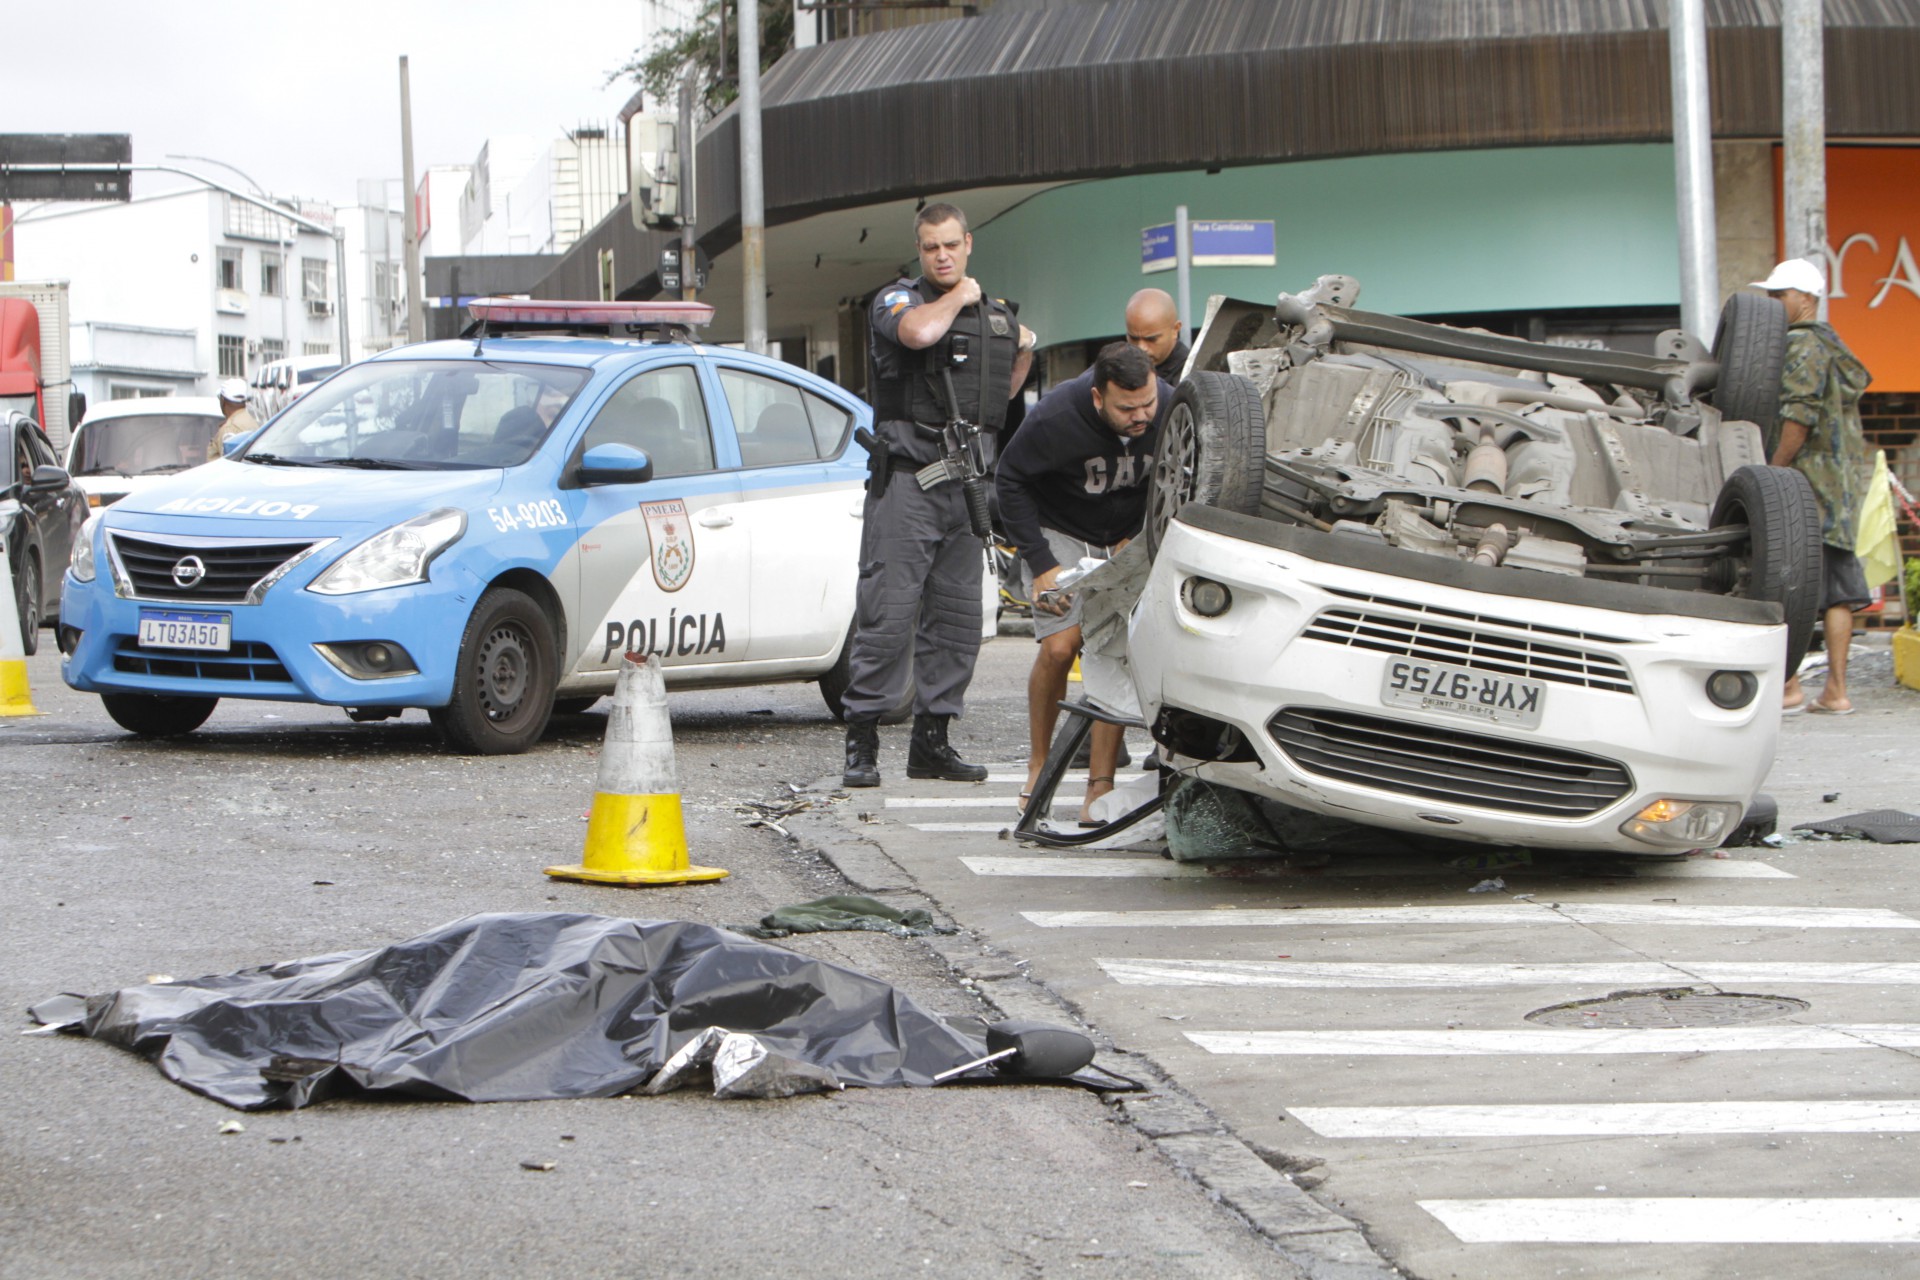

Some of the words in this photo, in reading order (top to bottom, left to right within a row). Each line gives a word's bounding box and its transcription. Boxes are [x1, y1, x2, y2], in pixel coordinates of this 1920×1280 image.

[1192, 222, 1210, 232] Rua
[487, 498, 568, 533] 54-9203
[644, 503, 683, 516] PMERJ
[147, 622, 219, 646] LTQ3A50
[601, 607, 726, 664] POLÍCIA
[1422, 697, 1455, 708] JANEIRO
